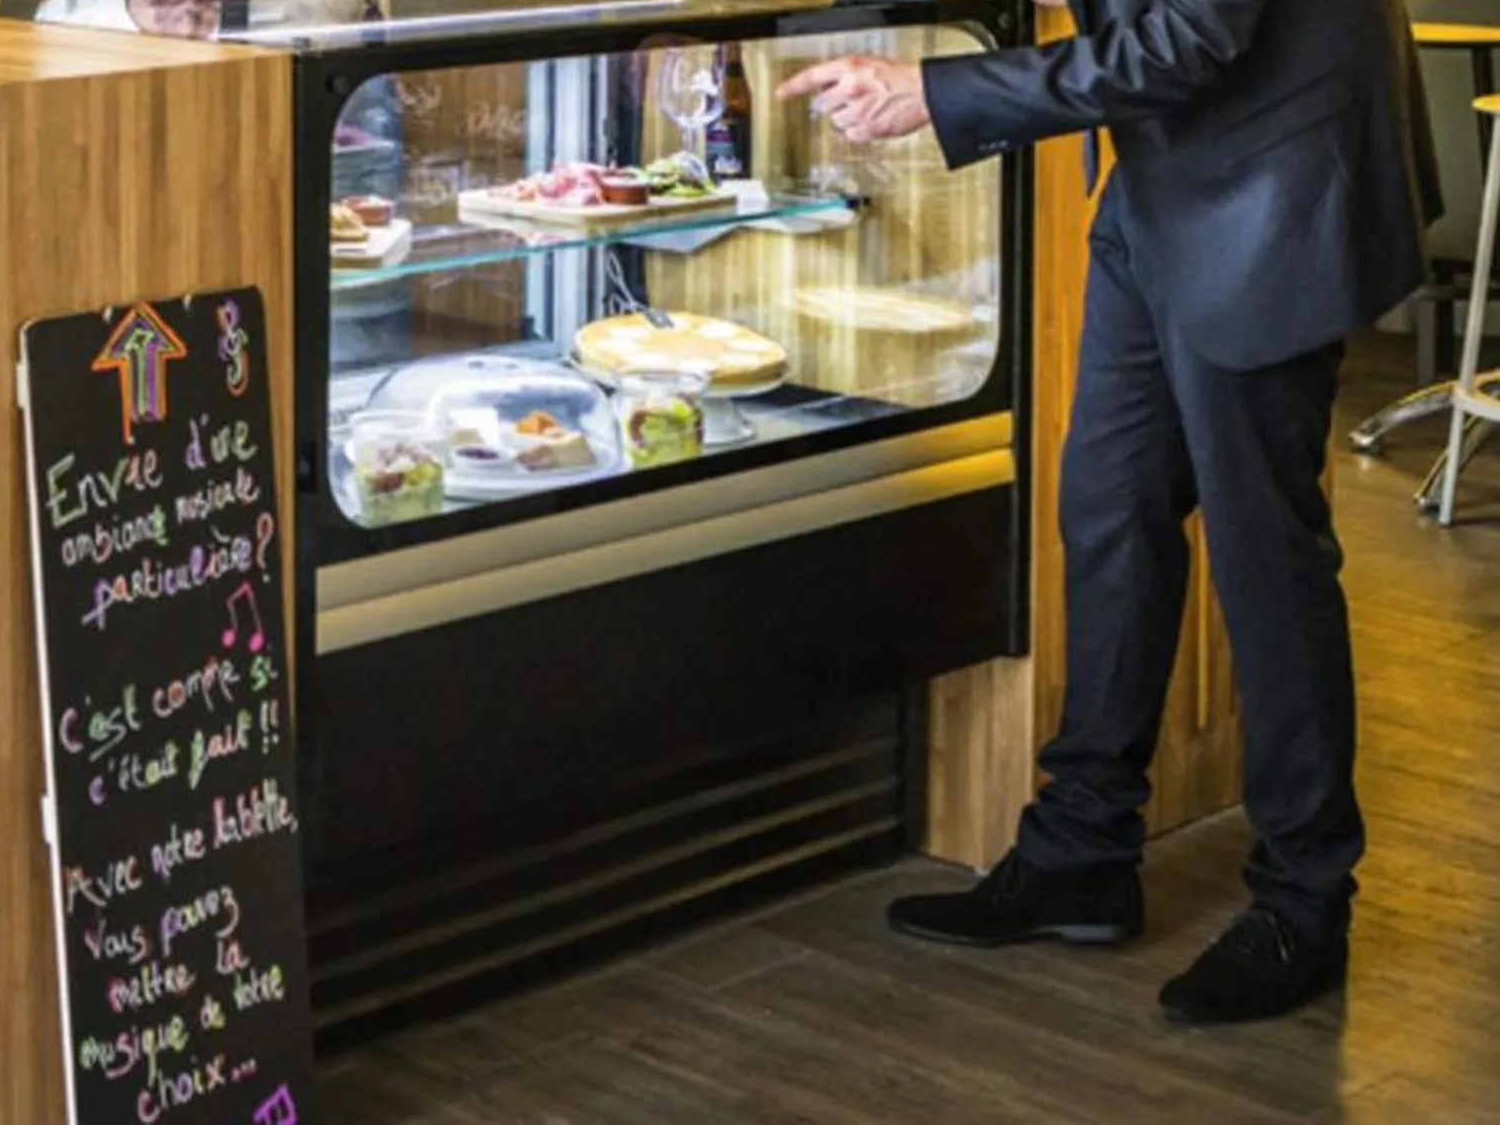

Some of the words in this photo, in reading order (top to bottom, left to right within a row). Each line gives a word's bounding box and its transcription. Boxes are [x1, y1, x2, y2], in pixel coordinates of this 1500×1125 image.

[45, 435, 163, 529] Envie
[62, 857, 143, 913] Avec
[216, 938, 251, 976] la
[199, 995, 226, 1031] de
